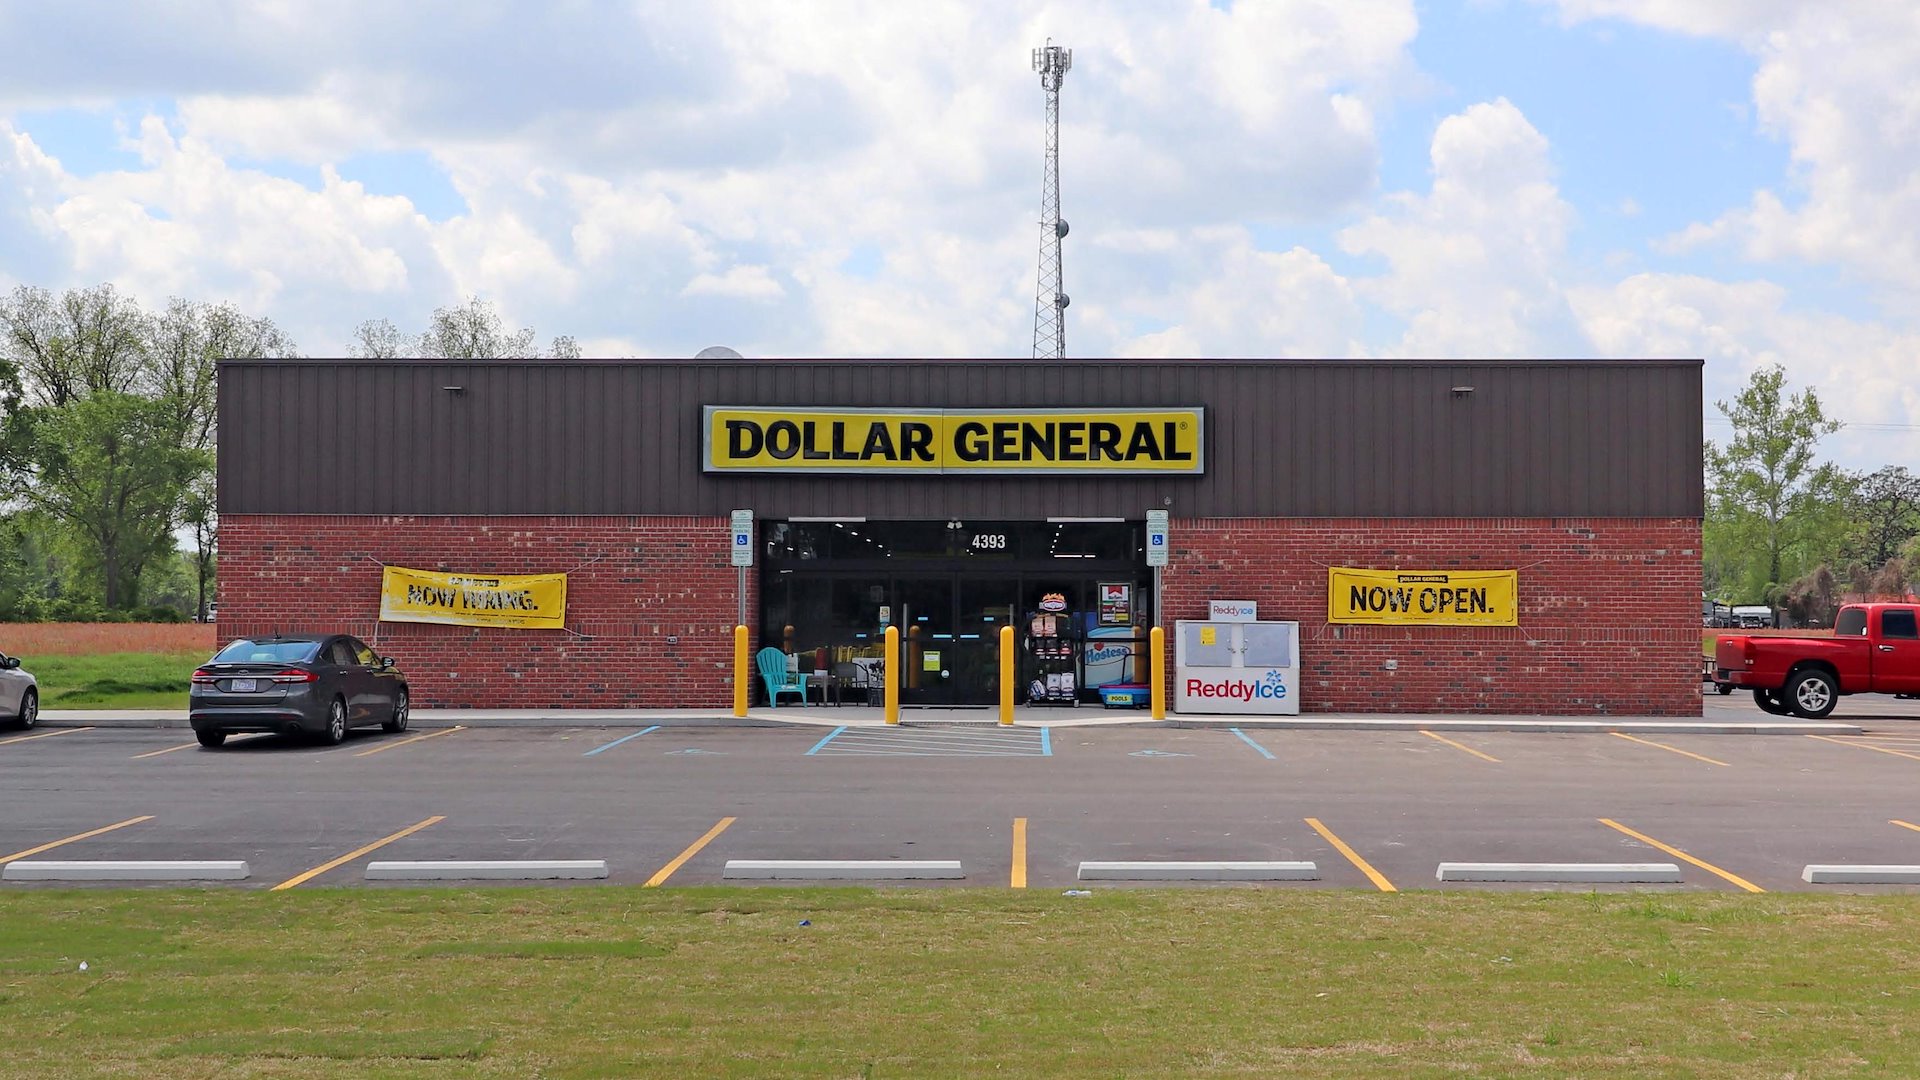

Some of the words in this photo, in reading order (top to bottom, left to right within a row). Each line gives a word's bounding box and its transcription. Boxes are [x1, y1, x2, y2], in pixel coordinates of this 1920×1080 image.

[725, 420, 935, 462] DOLLAR
[953, 421, 1192, 461] GENERAL
[972, 534, 1006, 549] 4393
[407, 584, 456, 608] NOW
[1350, 585, 1413, 613] NOW
[1419, 587, 1495, 614] OPEN.
[1085, 647, 1129, 664] Hostess
